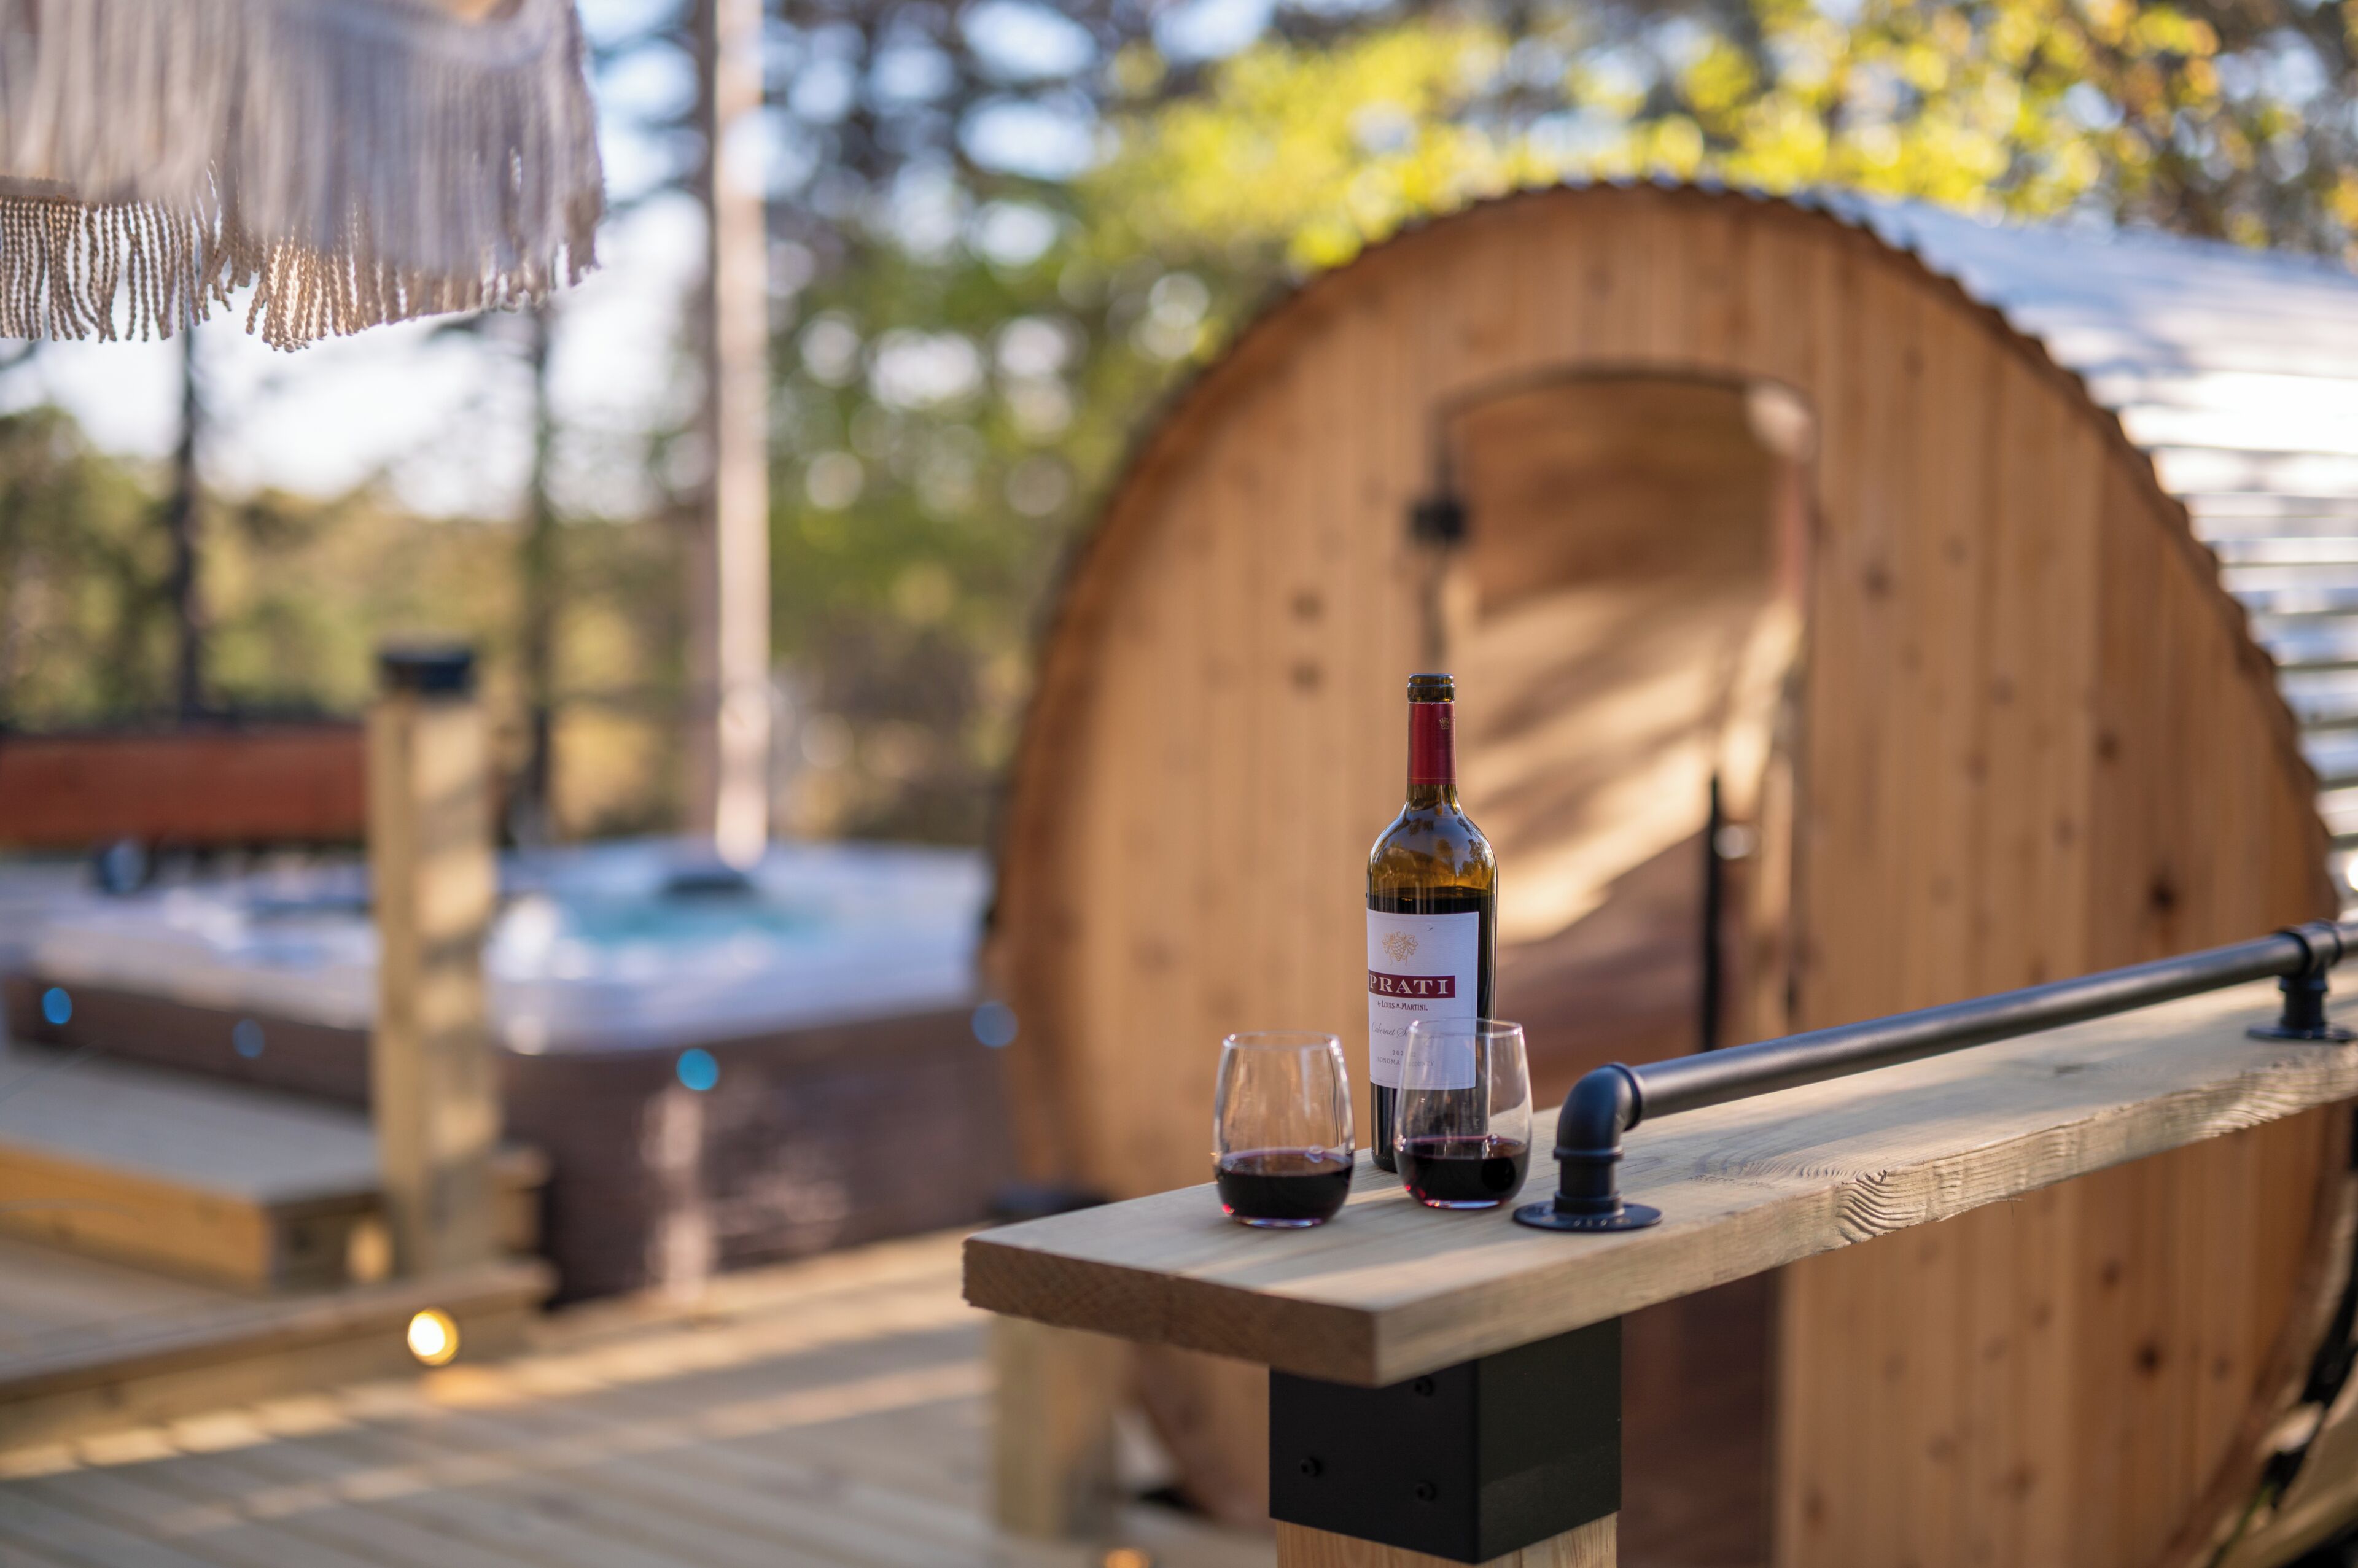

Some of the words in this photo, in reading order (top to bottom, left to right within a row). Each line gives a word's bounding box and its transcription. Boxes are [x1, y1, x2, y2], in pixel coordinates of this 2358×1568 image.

[1369, 974, 1448, 995] PRATI
[1372, 1021, 1395, 1035] Cabernet
[1377, 1057, 1400, 1065] SONOMA
